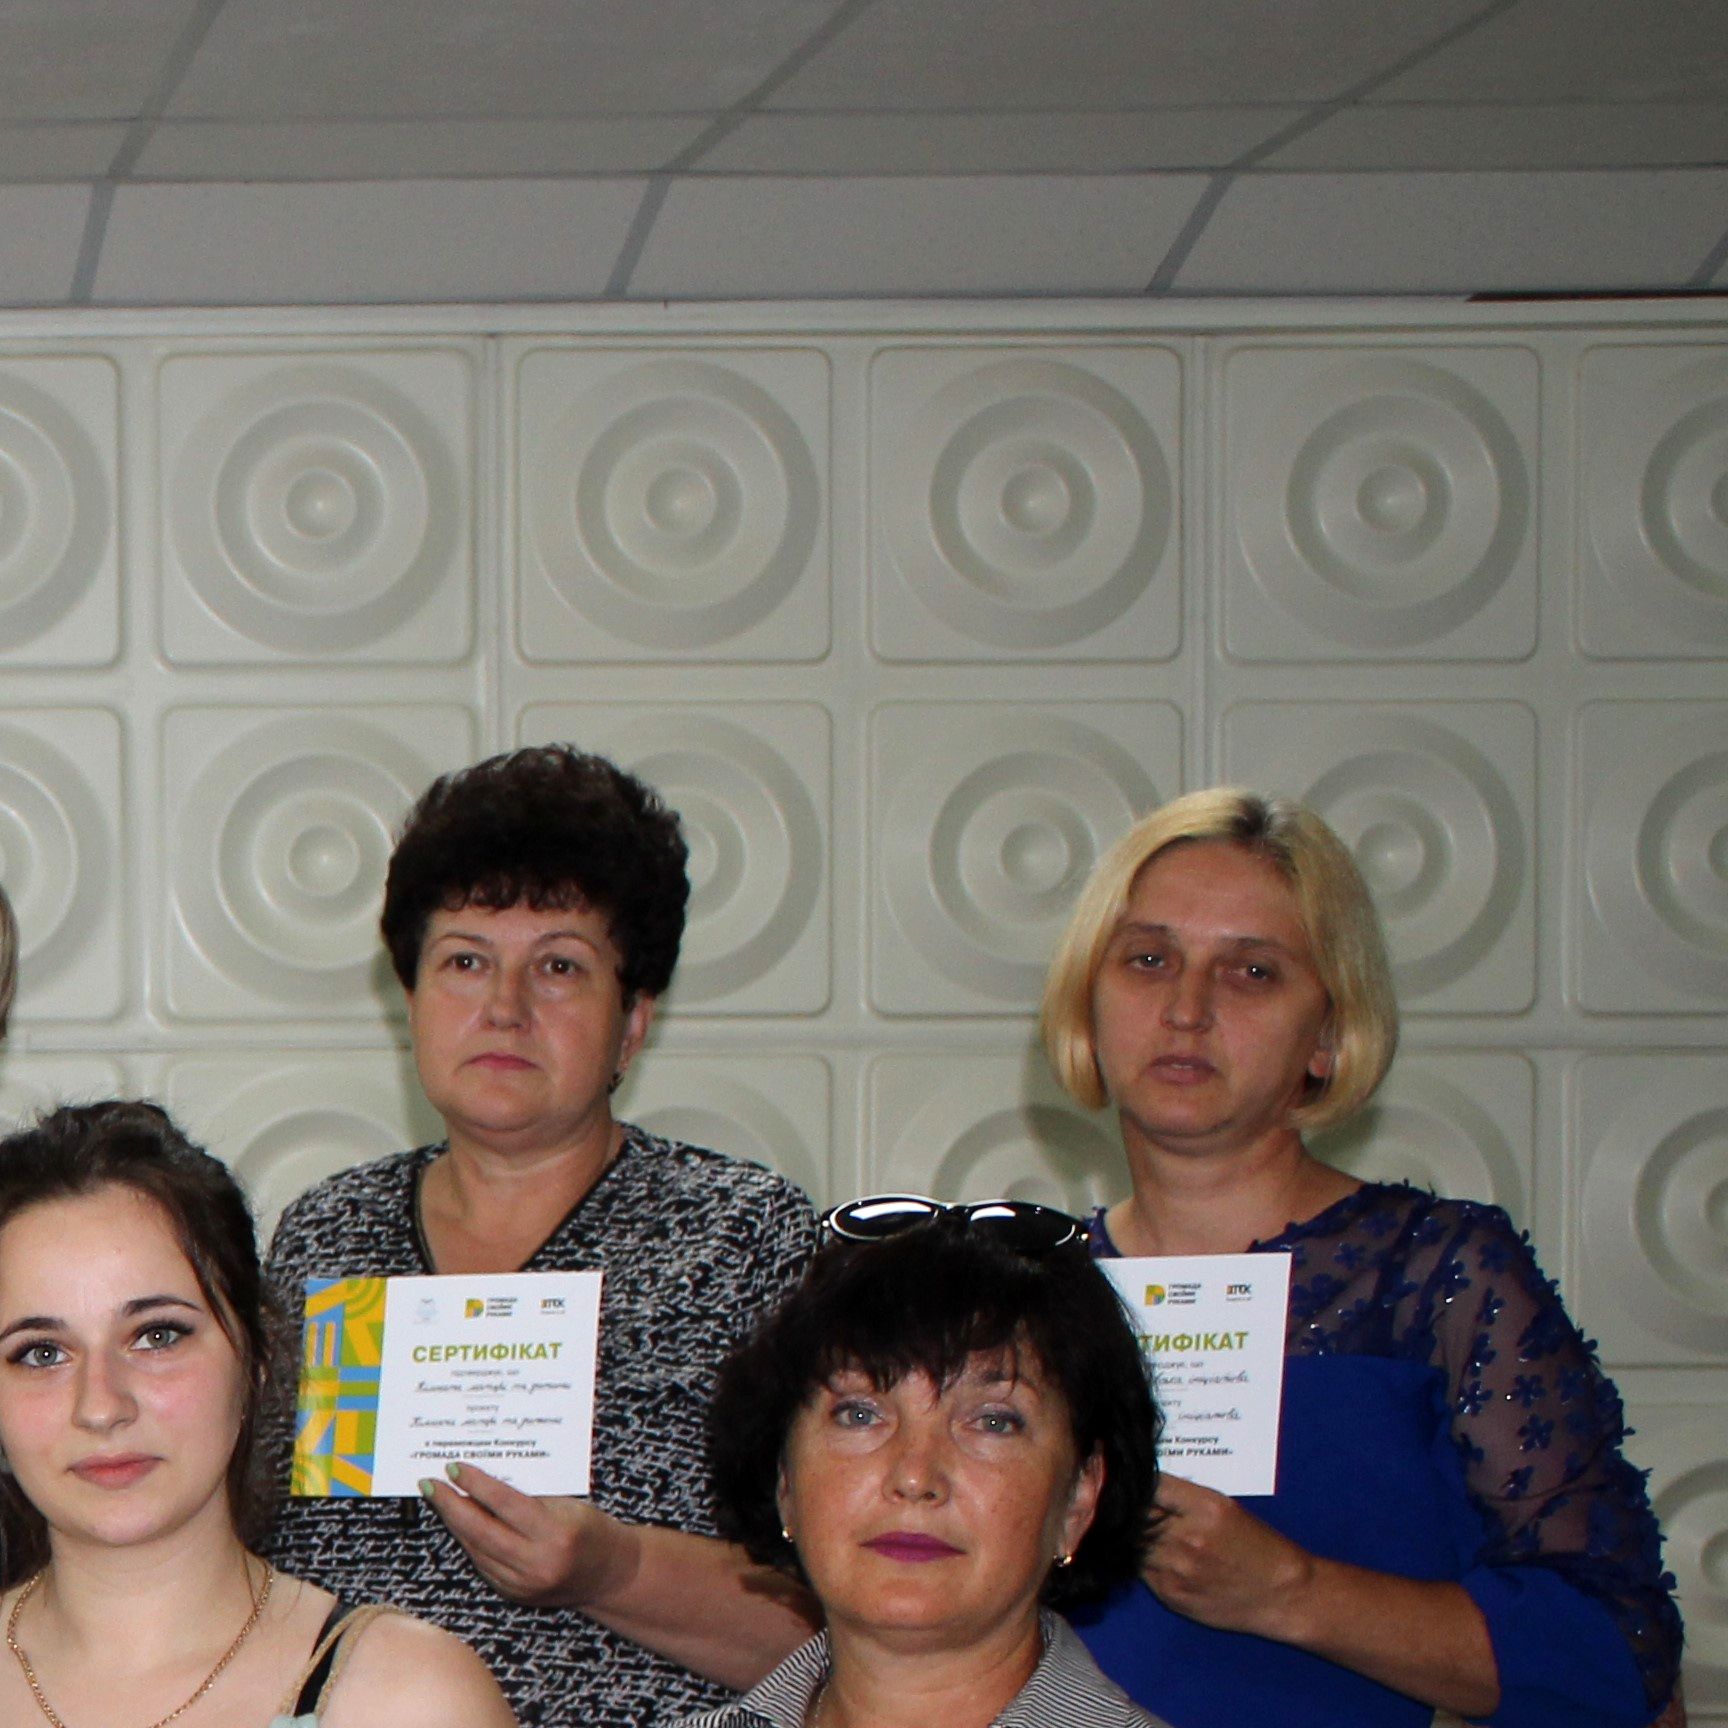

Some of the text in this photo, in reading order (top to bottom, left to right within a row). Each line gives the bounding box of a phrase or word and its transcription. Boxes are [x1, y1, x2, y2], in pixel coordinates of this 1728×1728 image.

[1139, 1331, 1249, 1351] ТИФІКАТ
[412, 1343, 563, 1363] СЕРТИФІКАТ
[464, 1451, 503, 1459] СВОЇМИ
